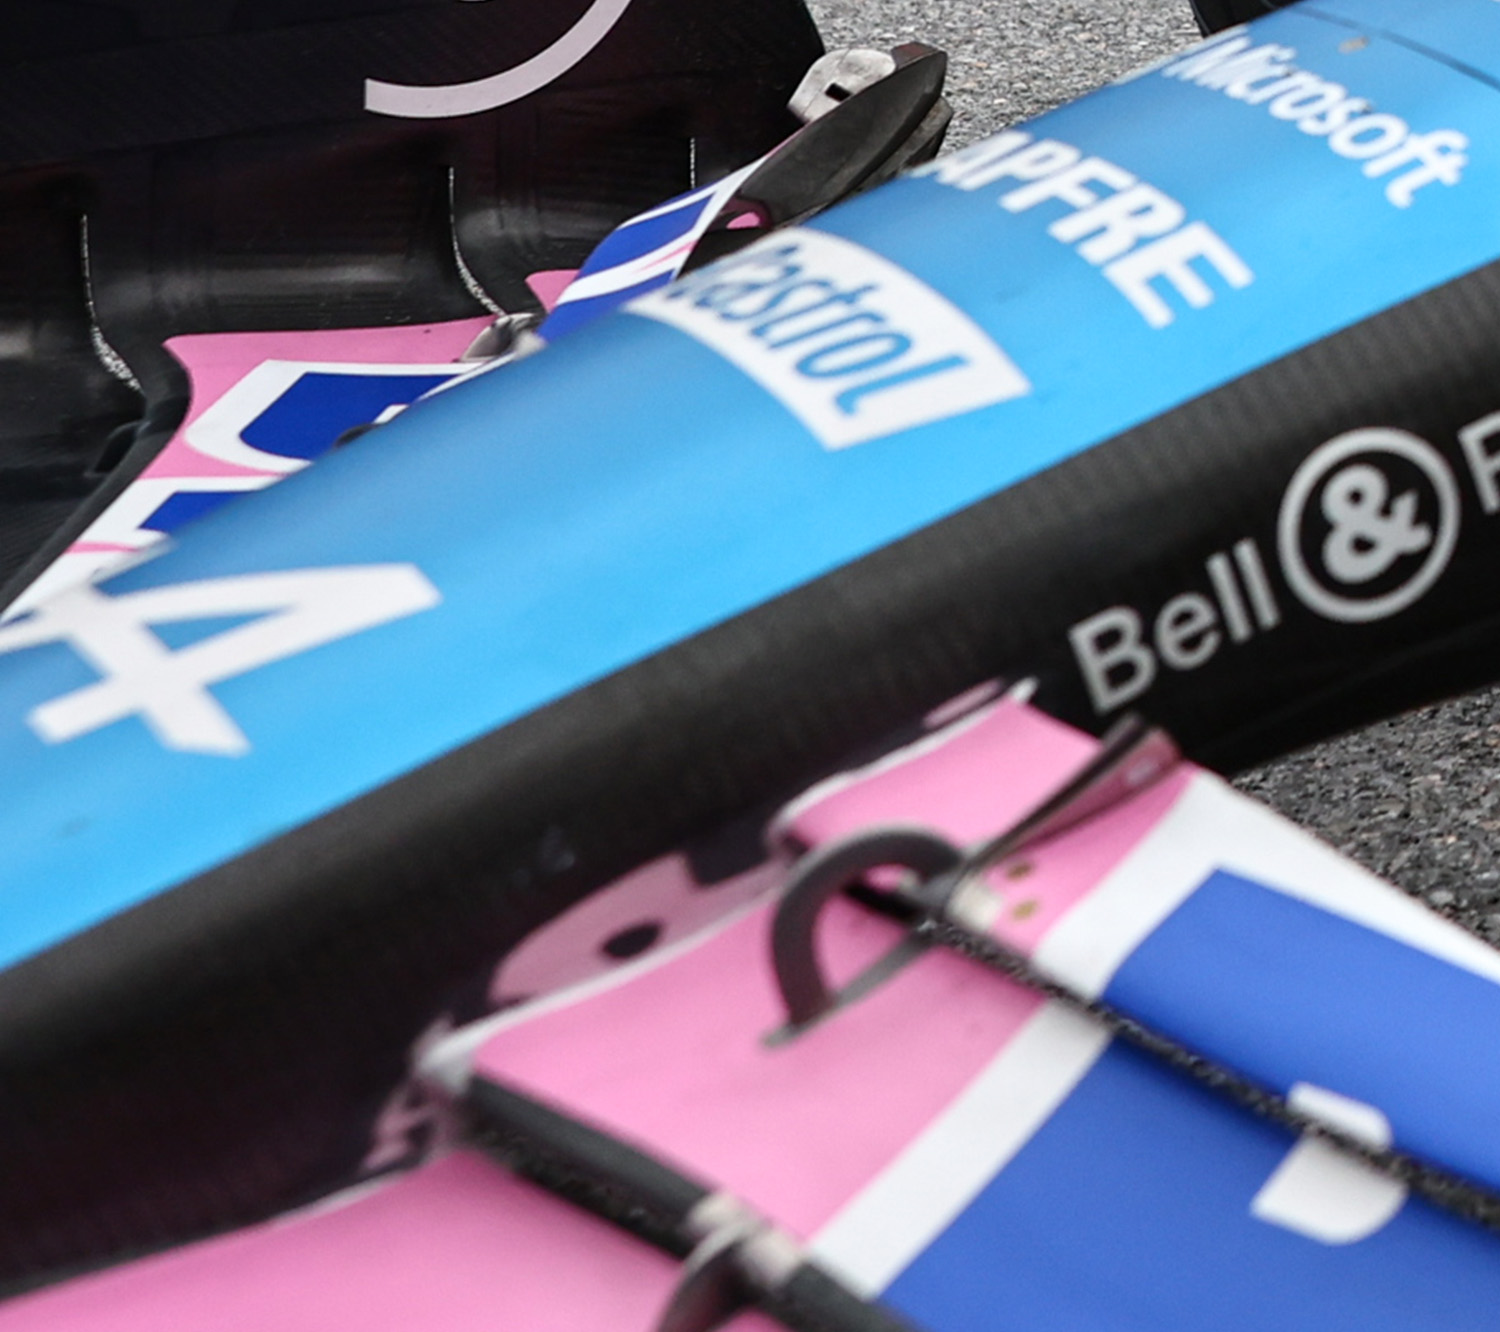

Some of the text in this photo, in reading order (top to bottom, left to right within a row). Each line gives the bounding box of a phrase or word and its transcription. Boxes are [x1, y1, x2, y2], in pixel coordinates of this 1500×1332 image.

[1160, 34, 1471, 211] Microsoft
[930, 130, 1256, 330] APFRE
[1067, 537, 1283, 715] Bell
